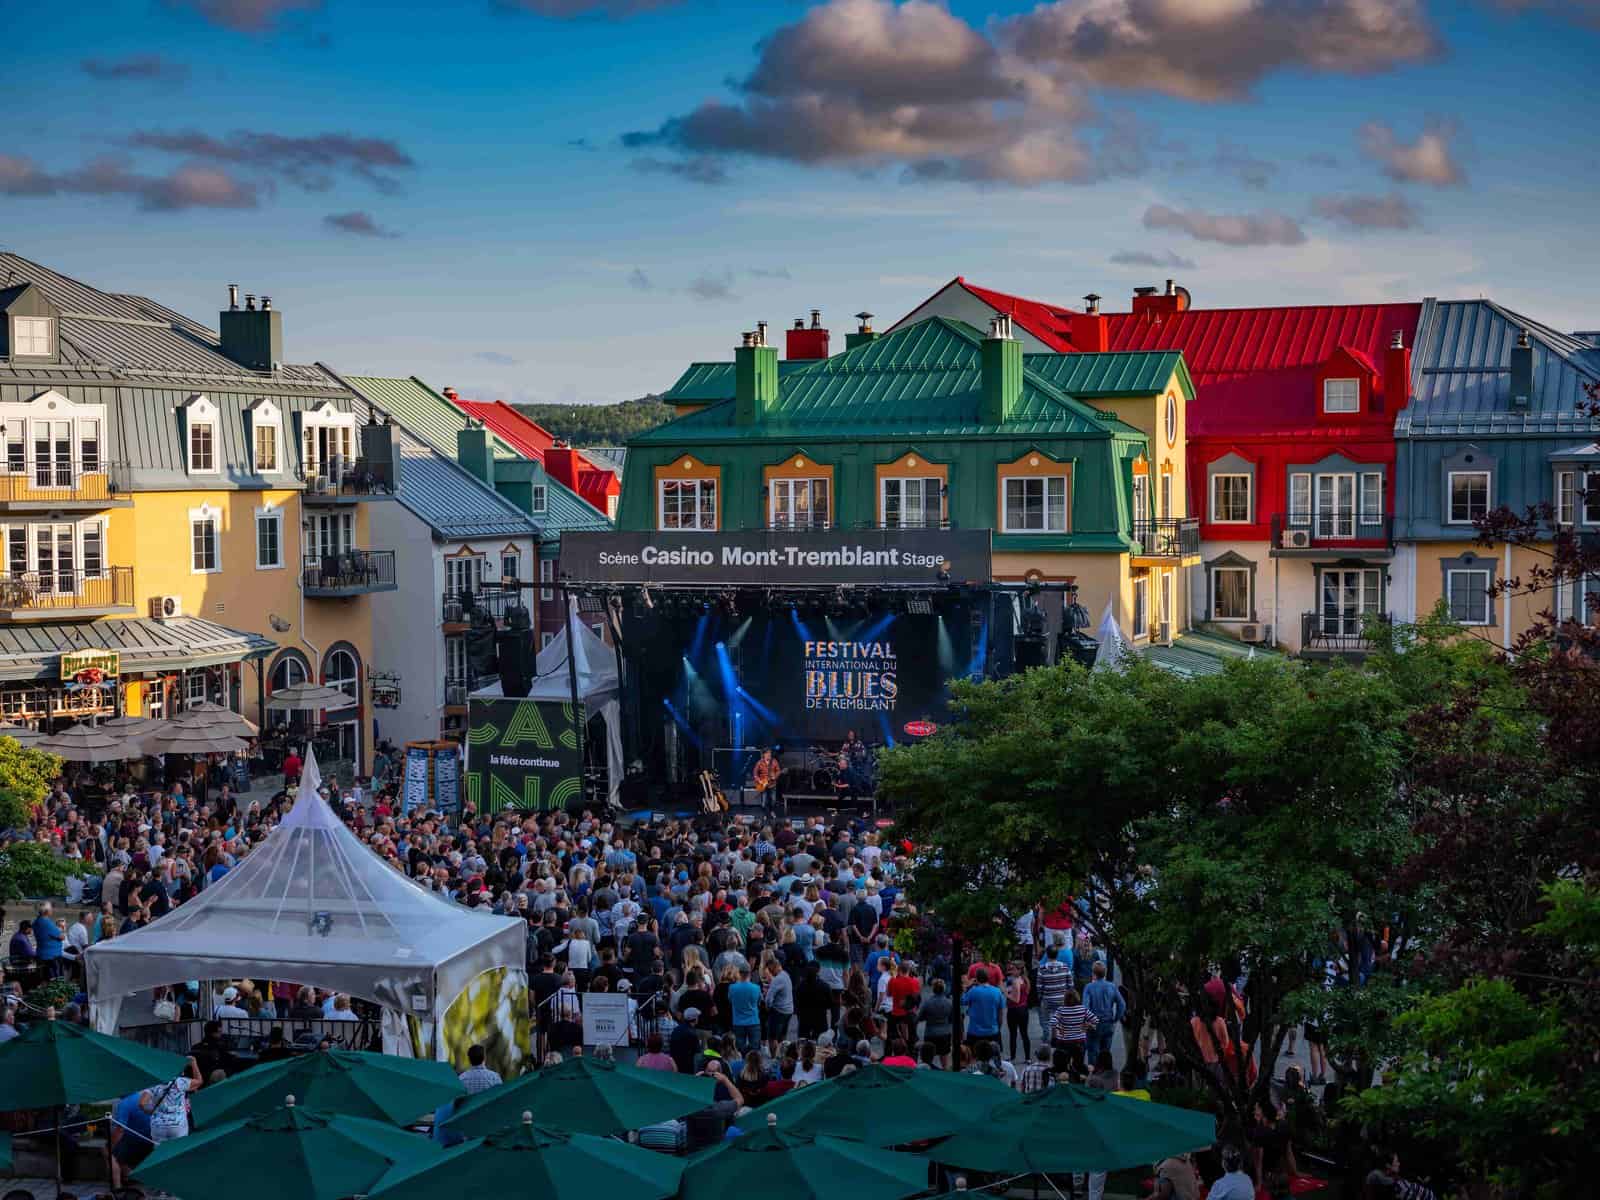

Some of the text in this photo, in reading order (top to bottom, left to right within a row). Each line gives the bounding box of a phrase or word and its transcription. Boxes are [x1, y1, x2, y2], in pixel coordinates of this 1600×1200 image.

[599, 545, 945, 568] Scène Casino Mont-Tremblant Stage
[805, 641, 896, 659] FESTIVAL
[805, 660, 897, 670] INTERNATIONAL DU
[806, 671, 897, 699] BLUES
[806, 698, 897, 710] DE TREMBLANT
[489, 754, 560, 769] la fête continue
